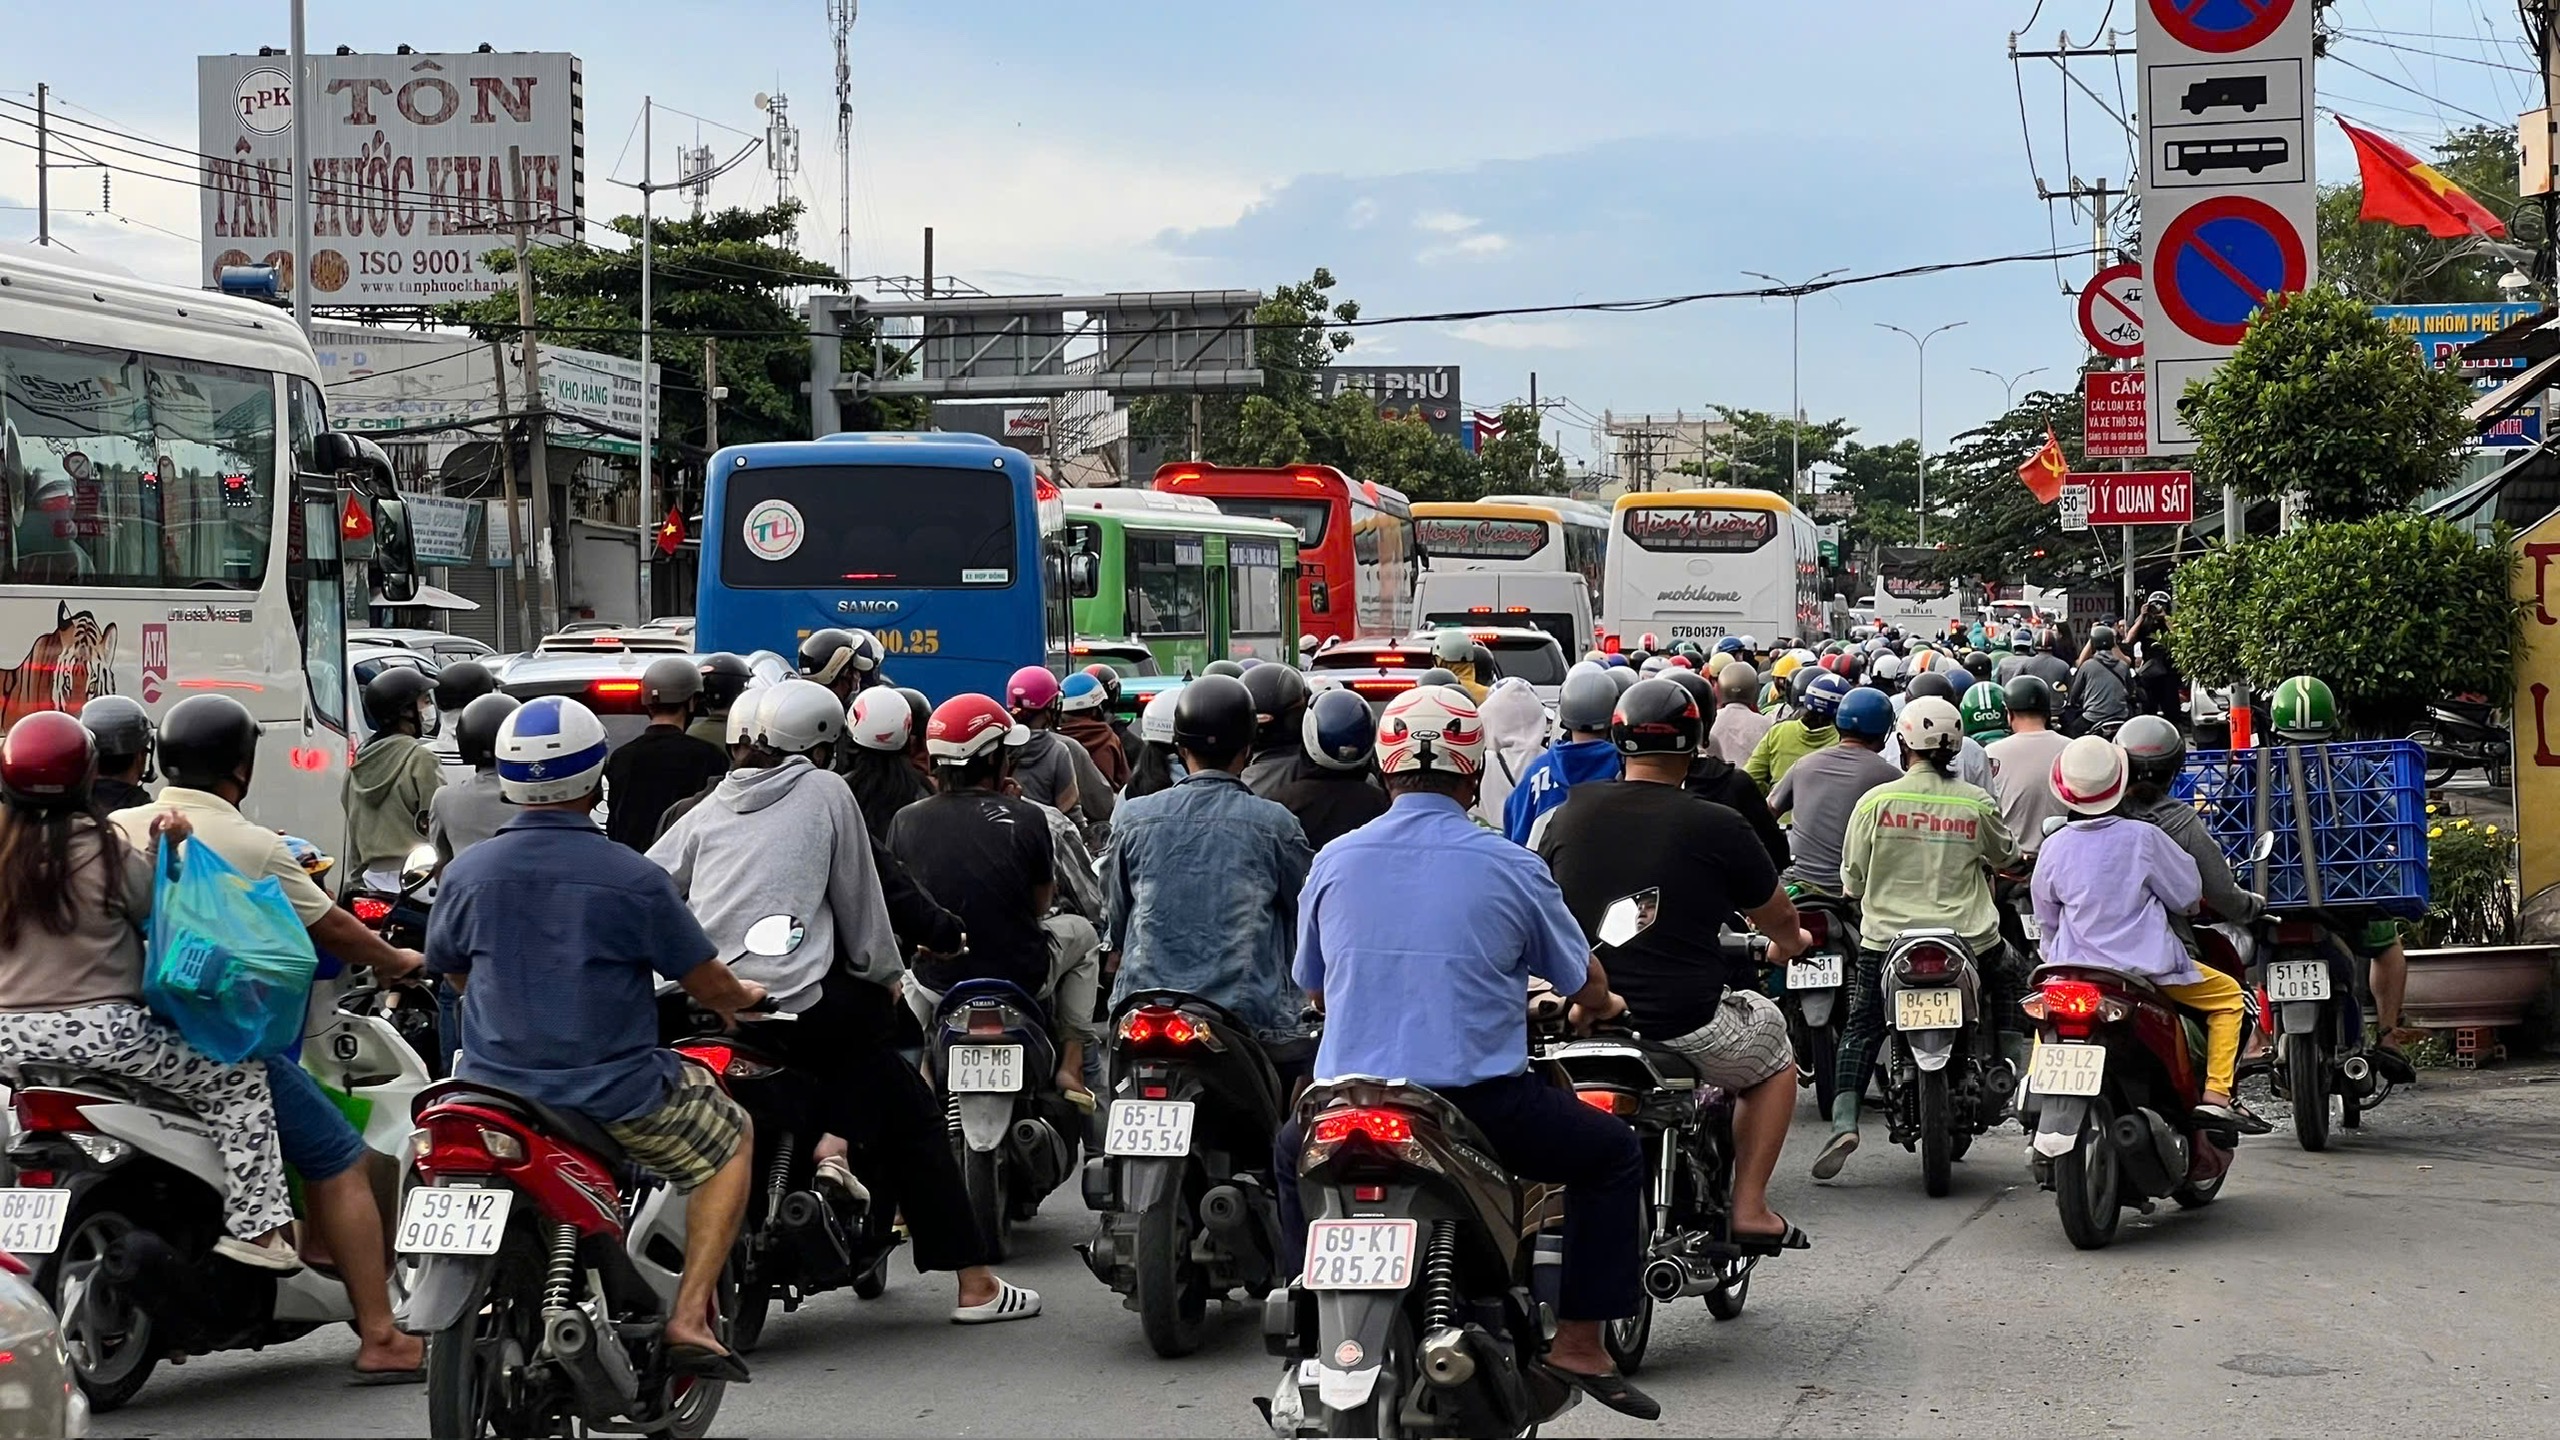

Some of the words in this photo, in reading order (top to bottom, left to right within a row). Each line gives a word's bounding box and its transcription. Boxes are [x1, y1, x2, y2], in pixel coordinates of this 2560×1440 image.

[240, 87, 291, 115] TPK
[325, 59, 538, 125] TÔN
[360, 251, 402, 274] ISO
[413, 250, 473, 274] 9001
[2424, 311, 2467, 333] NHÔM
[2472, 308, 2499, 331] PHẾ
[559, 380, 578, 400] KHO
[581, 376, 608, 405] HÀNG
[1385, 367, 1449, 399] PHÚ
[2110, 374, 2145, 395] CẤM
[2091, 399, 2106, 411] CÁC
[2107, 400, 2124, 413] LOẠI
[2125, 400, 2135, 411] XE
[2137, 400, 2142, 411] 3
[2089, 415, 2099, 427] VÀ
[2100, 417, 2110, 428] XE
[2101, 478, 2110, 513] Ý
[2116, 485, 2155, 514] QUAN
[2161, 477, 2187, 513] SÁT
[1415, 520, 1469, 546] Hùng
[1475, 520, 1542, 549] Cường
[1632, 510, 1691, 537] Hùng
[1696, 510, 1767, 538] Cường
[1657, 585, 1741, 602] mobihome
[837, 600, 899, 613] SAMCO
[144, 631, 167, 667] ATA
[1973, 711, 2001, 722] Grab
[1877, 810, 1908, 828] An
[1912, 812, 1978, 840] Phong
[1791, 972, 1839, 987] 915.88
[1906, 992, 1949, 1008] 84-G1
[1901, 1010, 1958, 1028] 375.44
[961, 1050, 1011, 1066] 60-M8
[2045, 1048, 2093, 1069] 59-L2
[961, 1070, 1011, 1088] 4146
[2035, 1070, 2098, 1092] 471.07
[1123, 1106, 1179, 1127] 65-L1
[1112, 1130, 1184, 1152] 295.54
[422, 1193, 495, 1221] 59-N2
[404, 1222, 494, 1250] 906.14
[1325, 1225, 1397, 1253] 69-K1
[1312, 1255, 1406, 1285] 285.26
